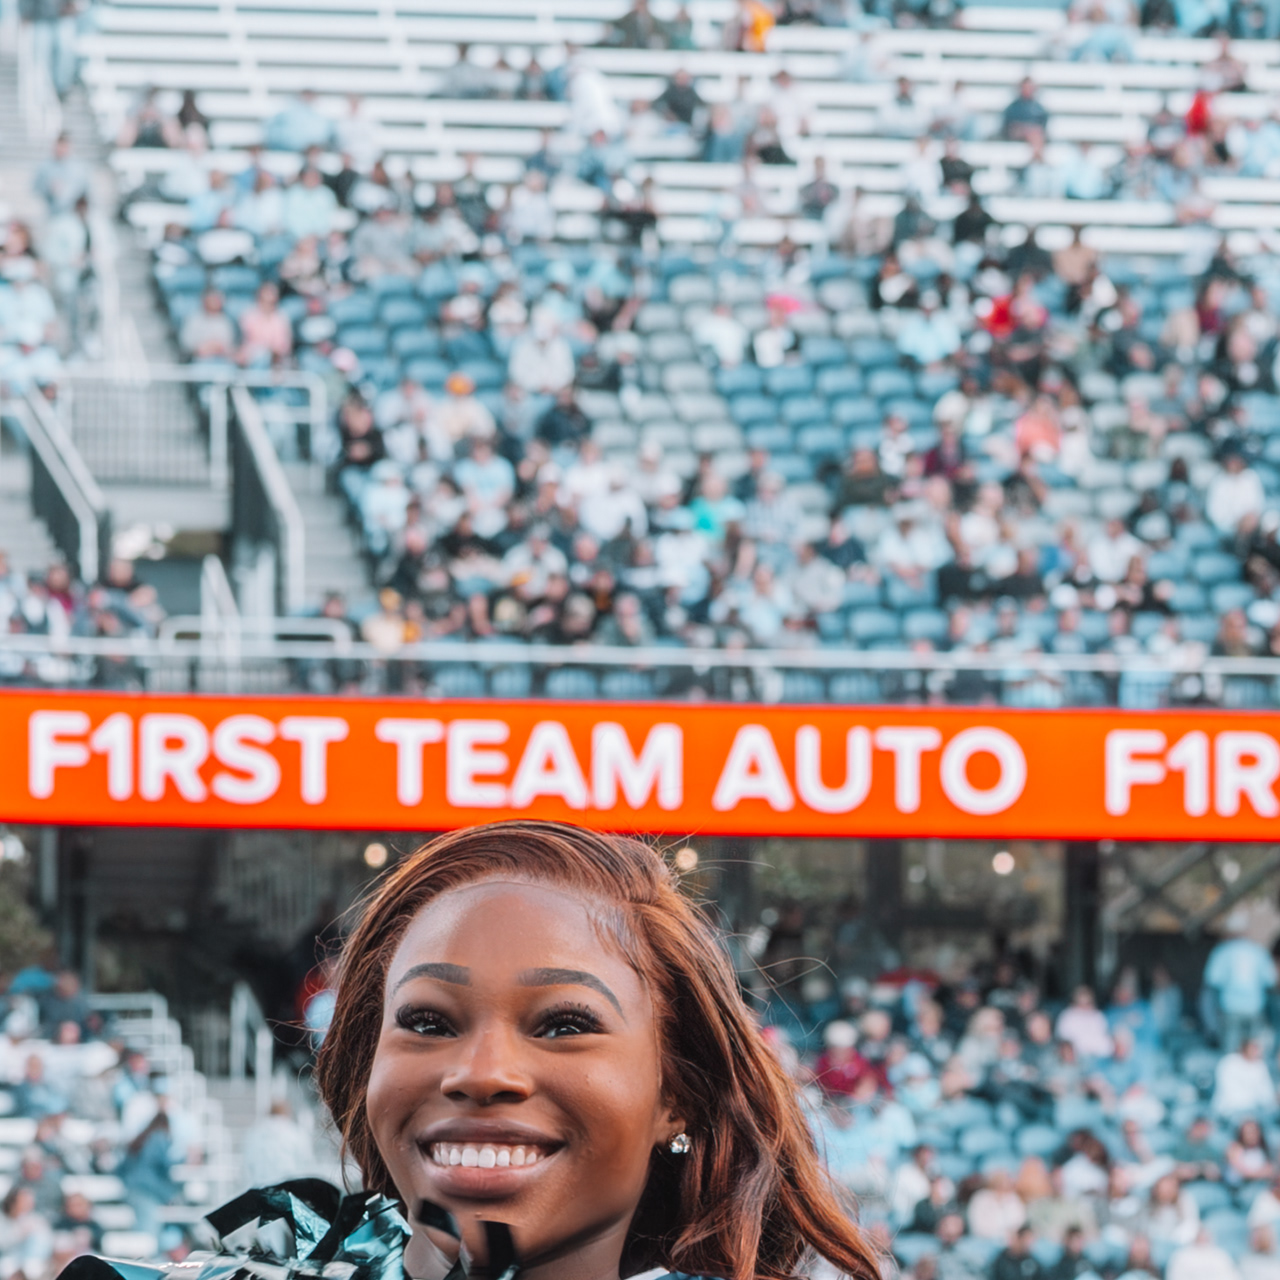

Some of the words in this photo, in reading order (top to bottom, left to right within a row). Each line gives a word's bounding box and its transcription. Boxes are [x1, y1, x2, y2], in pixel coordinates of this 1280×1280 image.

[28, 710, 349, 805] F1RST
[375, 718, 684, 811] TEAM
[712, 724, 1027, 815] AUTO
